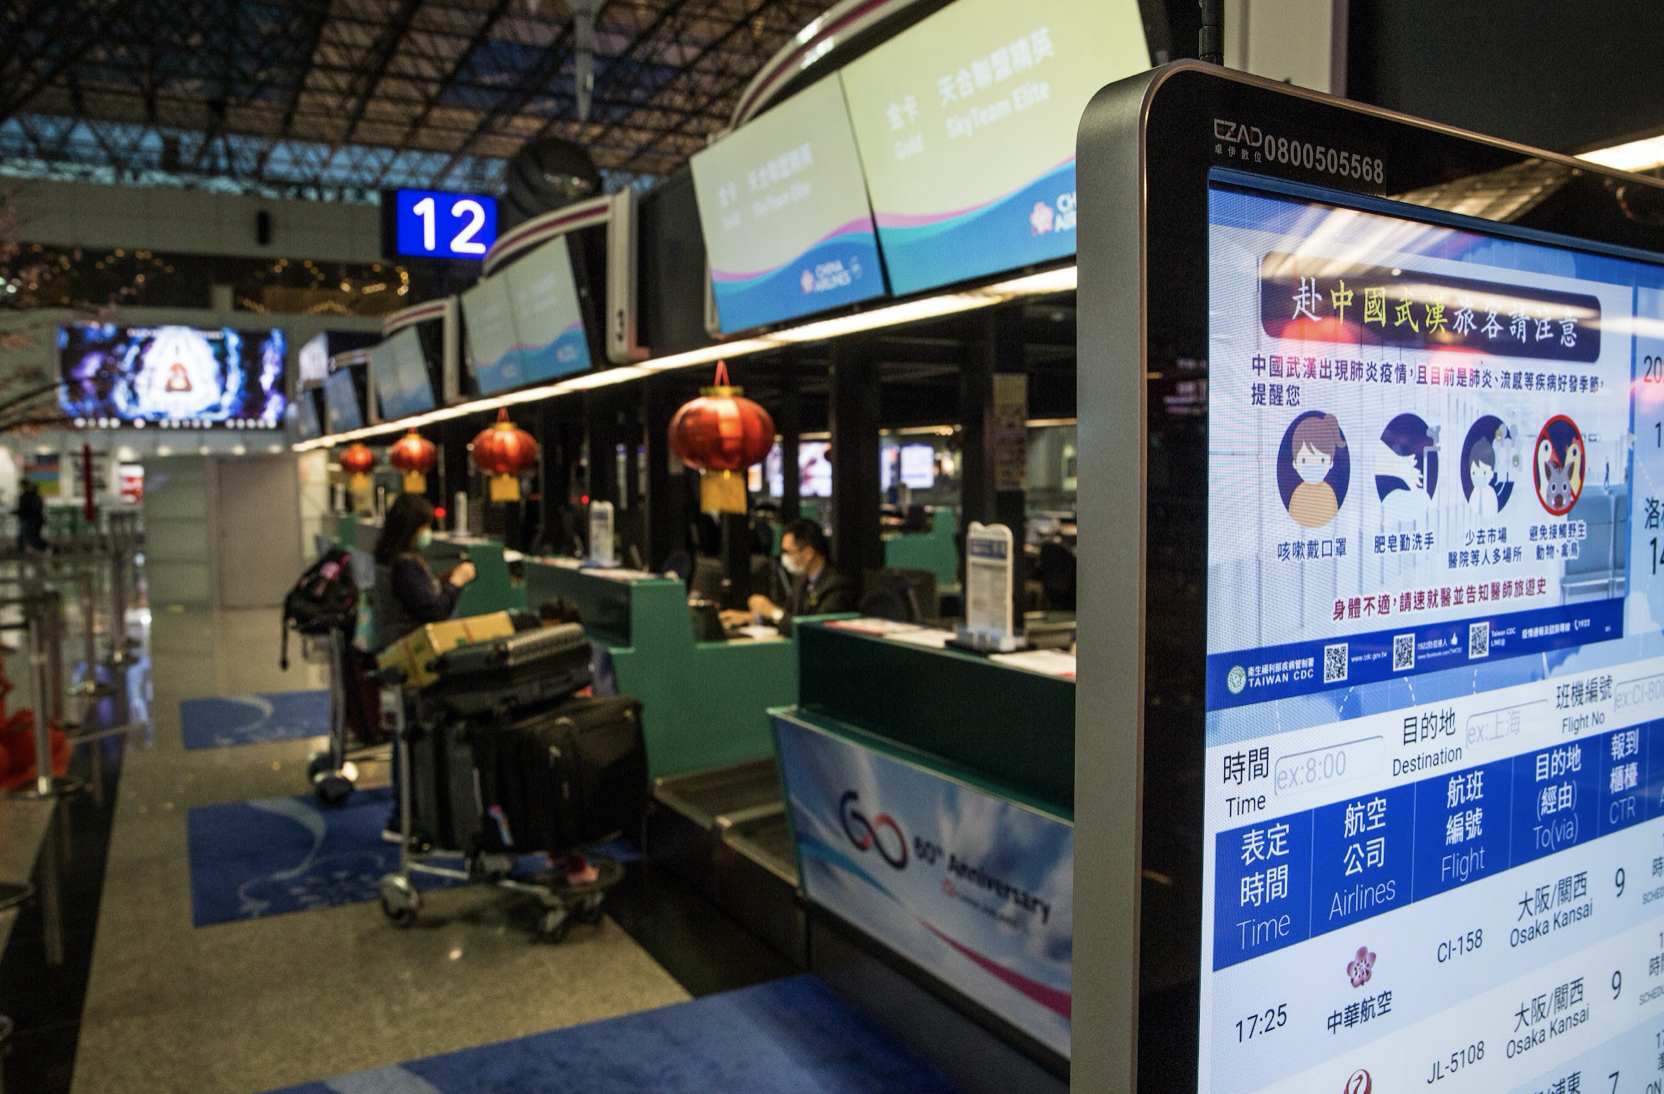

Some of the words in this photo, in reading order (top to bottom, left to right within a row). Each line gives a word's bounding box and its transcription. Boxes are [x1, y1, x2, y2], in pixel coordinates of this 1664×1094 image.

[1214, 143, 1262, 164] 卓伊數位
[1264, 134, 1384, 184] 0800505568
[412, 197, 487, 255] 12
[1292, 276, 1579, 348] 赴中國武漢旅客請注意
[1643, 355, 1664, 384] 20
[1251, 382, 1301, 407] 提醒您
[1277, 537, 1347, 563] 咳嗽戴口罩
[1373, 531, 1435, 555] 肥皂勤洗手
[1465, 526, 1508, 547] 少去市場
[1529, 521, 1586, 542] 避免接觸野生
[1448, 546, 1523, 569] 醫院等人多場所
[1332, 576, 1547, 621] 身體不適，請速就醫並告知醫師旅遊史
[1506, 627, 1516, 636] CDC
[1350, 651, 1388, 663] www.cdc.gov.tw
[1248, 672, 1289, 688] TAIWAN
[1293, 668, 1314, 681] CDC
[1555, 674, 1613, 711] 班機編號
[1402, 707, 1456, 746] 目的地
[1562, 714, 1589, 735] Flight
[1591, 711, 1606, 726] No
[1392, 746, 1463, 777] Destination
[1535, 743, 1582, 783] 目的地
[1610, 728, 1640, 762] 報到
[1223, 746, 1270, 785] 時間
[1276, 750, 1347, 790] ex:8:00
[1609, 762, 1639, 795] 櫃檯
[1225, 795, 1266, 818] Time
[1446, 770, 1484, 809] 航班
[1537, 780, 1578, 822] (經由)
[1343, 796, 1387, 839] 航空
[1445, 807, 1483, 846] 編號
[1609, 795, 1636, 825] CTR
[839, 790, 909, 871] 60
[1241, 822, 1290, 866] 表定
[1533, 813, 1579, 850] To(via)
[1343, 837, 1385, 877] 公司
[1441, 846, 1485, 882] Flight
[947, 853, 1050, 926] Anniversary
[1240, 864, 1288, 908] 時間
[1329, 879, 1396, 921] Airlines
[1517, 870, 1588, 922] 大阪/關西
[1615, 867, 1626, 898] 9
[1236, 914, 1291, 950] Time
[1509, 918, 1550, 948] Osaka
[1553, 898, 1593, 932] Kansai
[1437, 928, 1484, 963] CI-158
[1611, 970, 1622, 1000] 9
[1234, 1003, 1288, 1043] 17:25
[1327, 990, 1393, 1035] 中華航空
[1514, 976, 1585, 1033] 大阪/關西
[1506, 1028, 1546, 1059] Osaka
[1549, 1003, 1590, 1039] Kansai
[1427, 1040, 1486, 1084] JL-5108
[1608, 1070, 1620, 1094] 7
